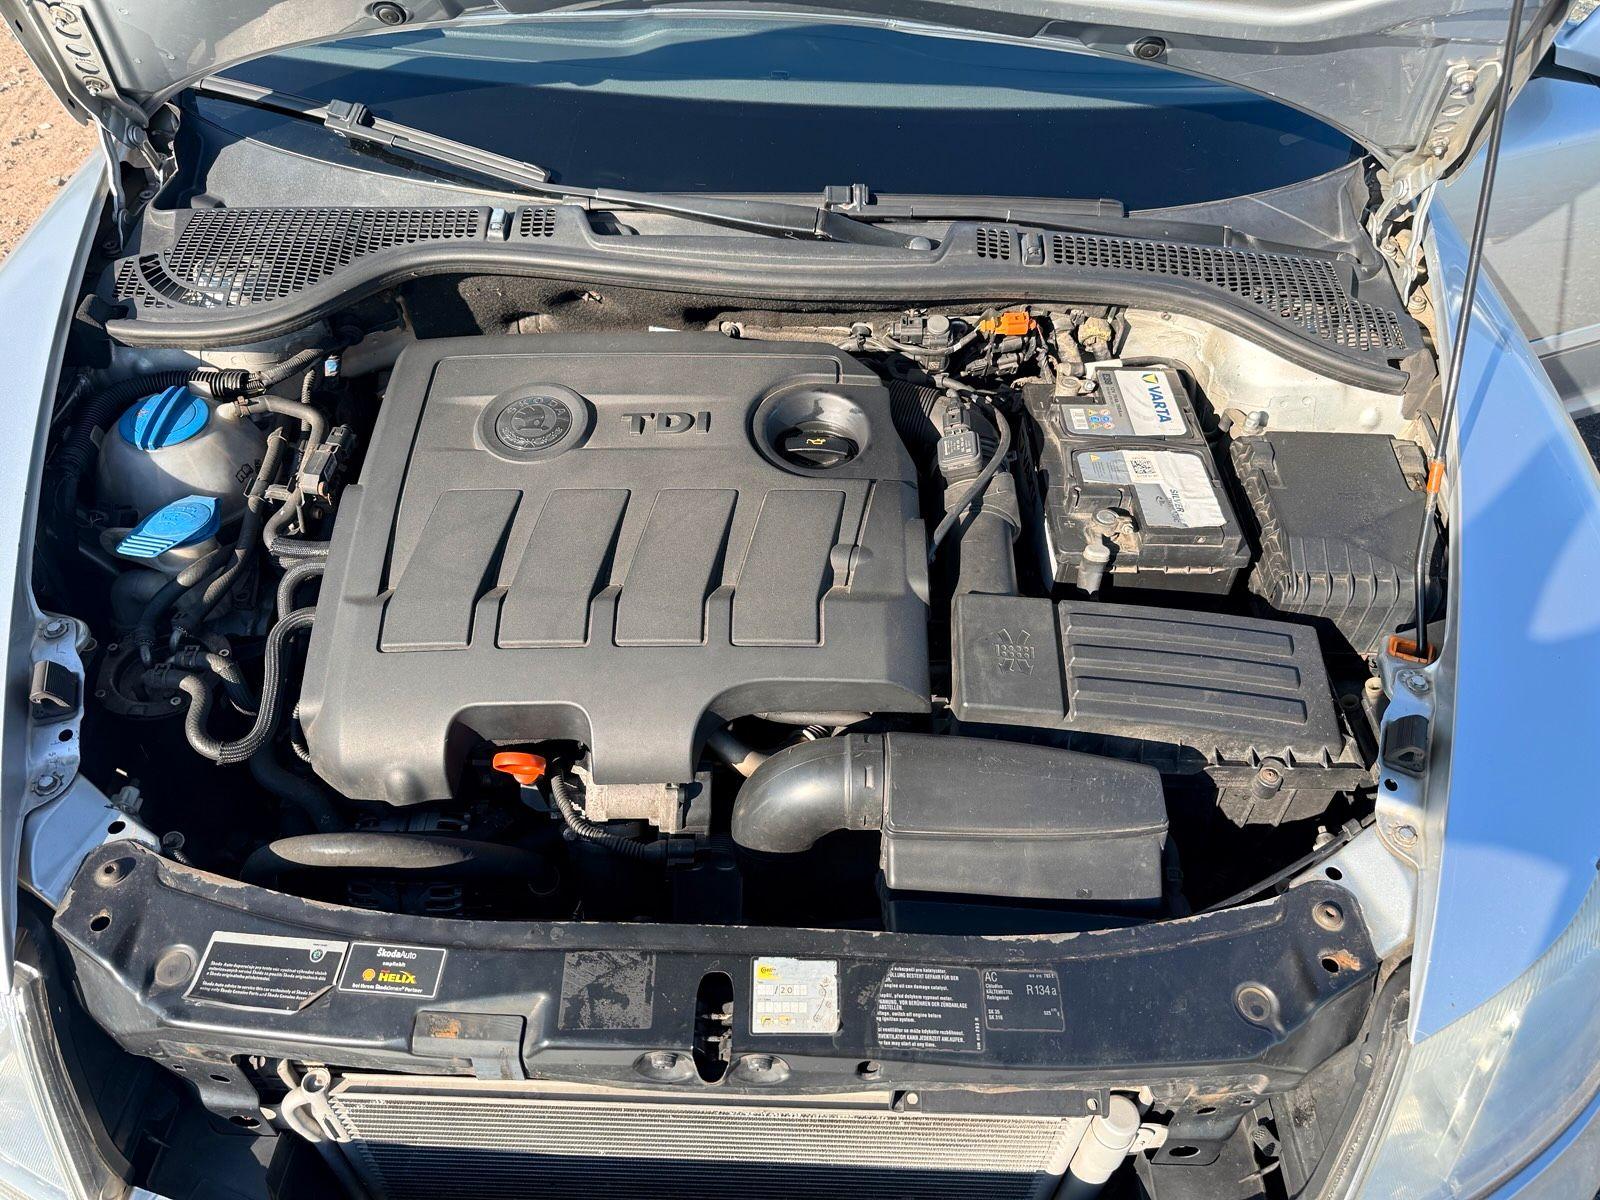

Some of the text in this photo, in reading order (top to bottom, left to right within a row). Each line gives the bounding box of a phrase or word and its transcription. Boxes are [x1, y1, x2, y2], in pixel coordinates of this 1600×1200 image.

[1148, 386, 1172, 422] VARTA
[620, 411, 711, 437] TDI
[1169, 489, 1185, 513] SILVER
[376, 947, 417, 960] ŠkodaAuto
[378, 971, 416, 984] HELIX
[984, 972, 998, 982] AC
